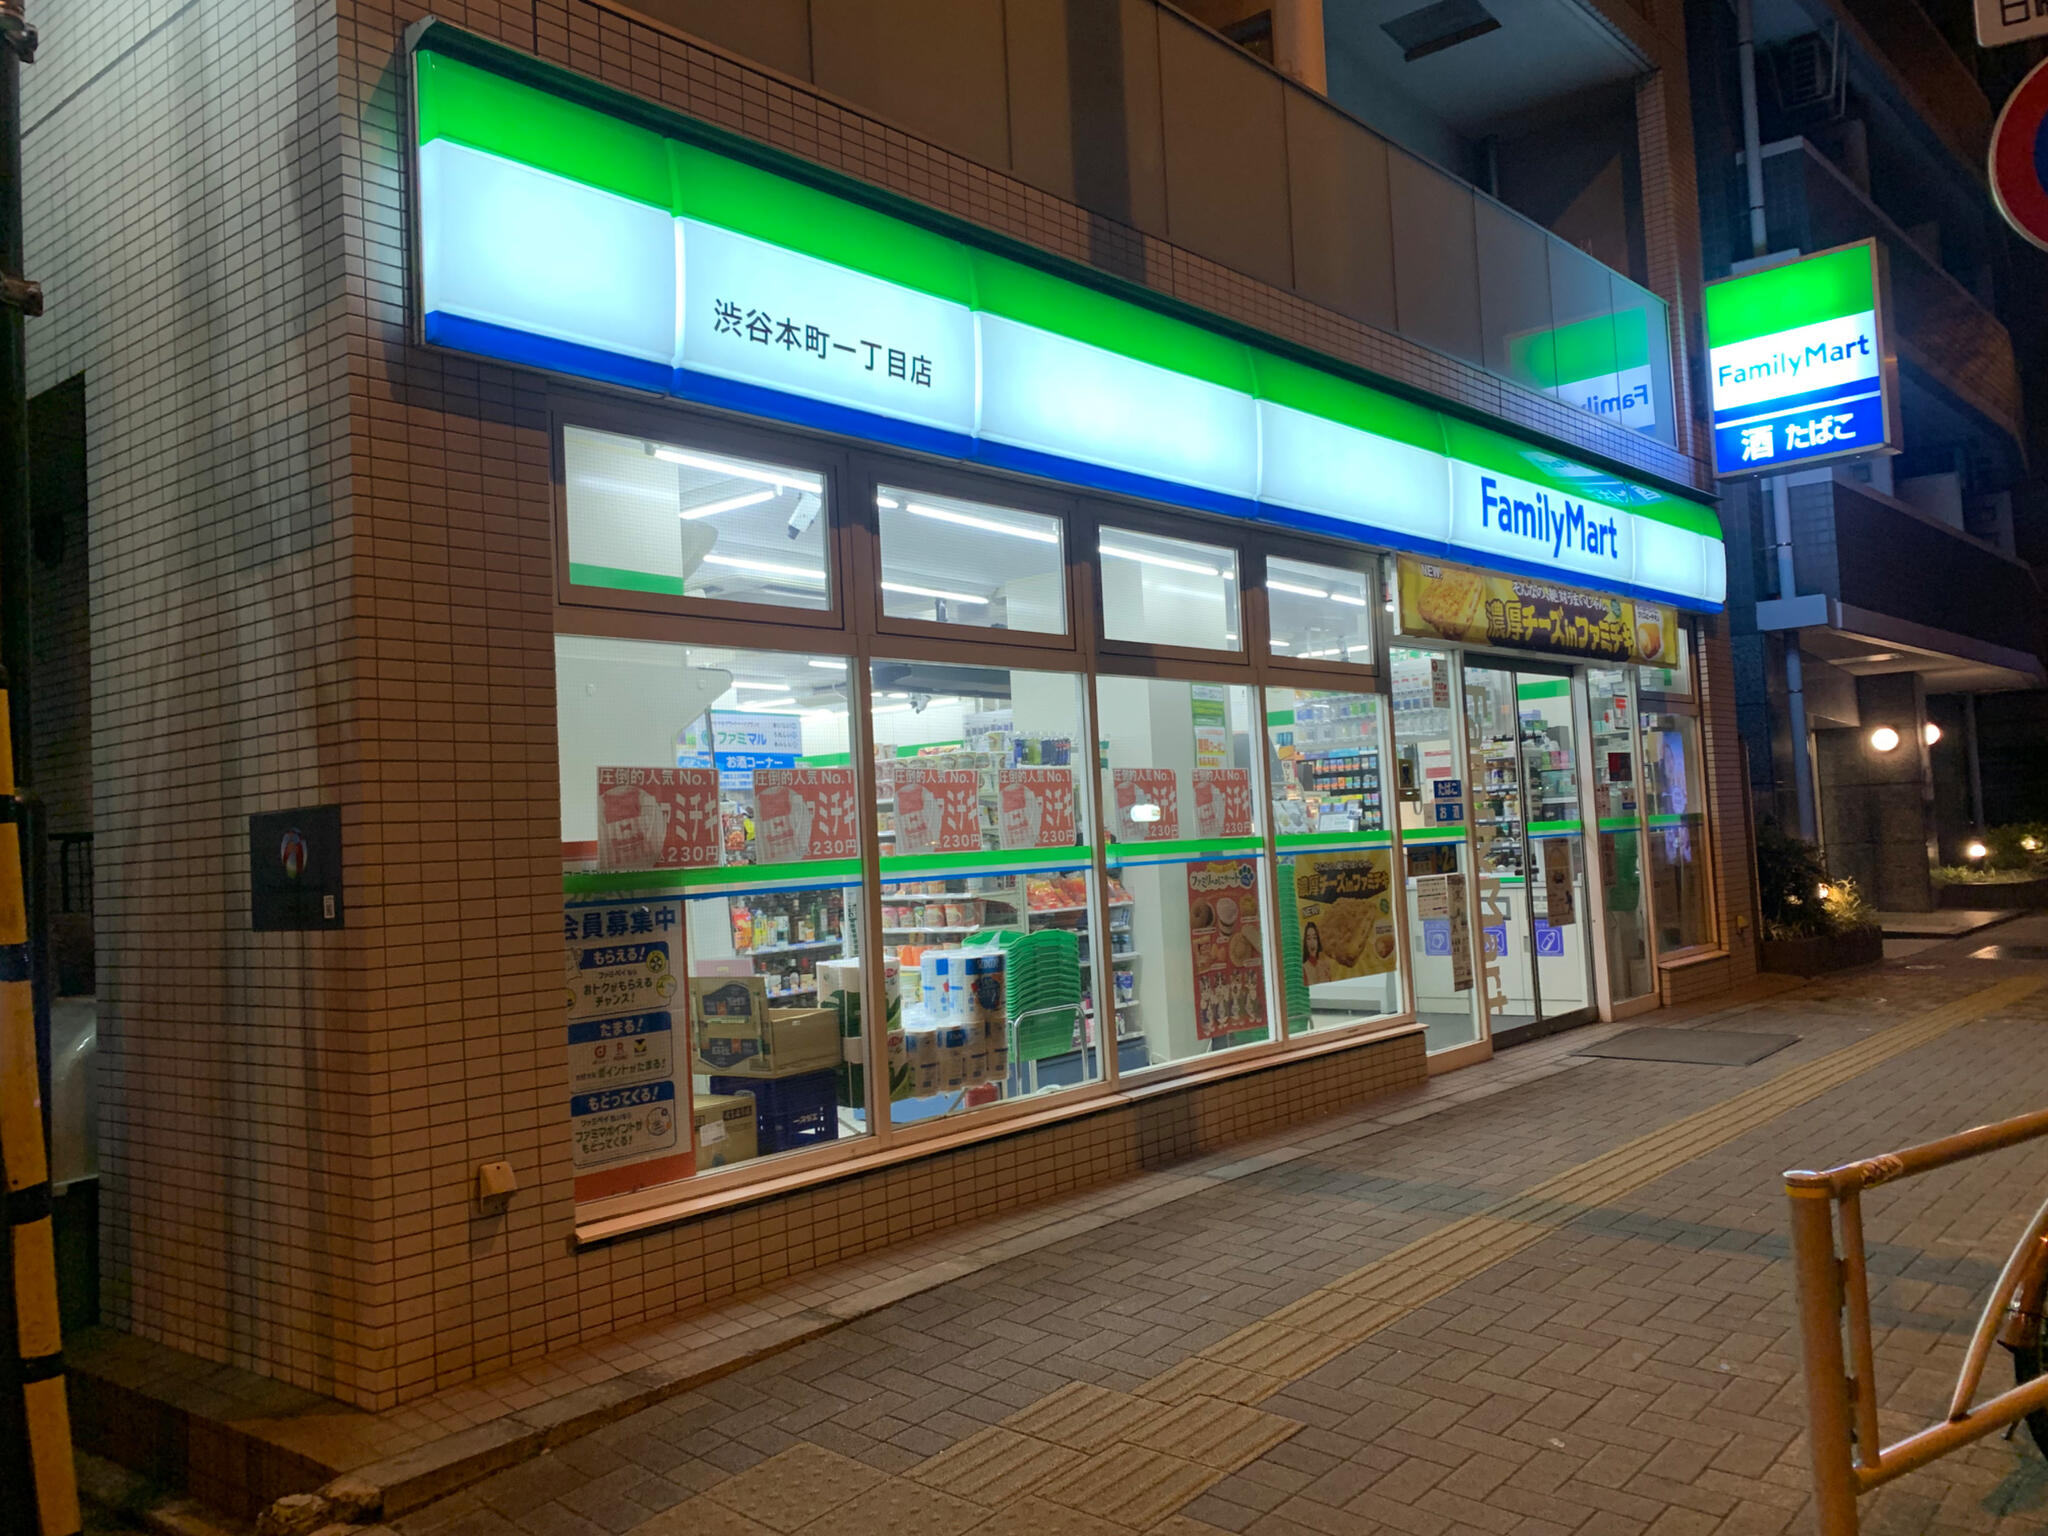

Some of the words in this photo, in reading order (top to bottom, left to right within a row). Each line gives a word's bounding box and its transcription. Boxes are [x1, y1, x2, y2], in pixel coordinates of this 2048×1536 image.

[714, 298, 932, 388] 渋谷本町一丁目店
[1718, 335, 1870, 387] FamilyMart
[1741, 425, 1774, 461] 酒
[1785, 413, 1857, 451] たばこ
[1481, 476, 1618, 559] FamilyMart
[1486, 598, 1636, 657] 濃厚チーズinファミチキ
[716, 731, 767, 745] ファミマル
[726, 756, 783, 769] お酒コーナー
[599, 769, 674, 786] 圧倒的人気
[679, 770, 715, 786] No.1
[755, 770, 818, 786] 圧倒的人気
[822, 770, 853, 786] No.1
[950, 770, 976, 784] No.1
[1047, 769, 1070, 783] No.1
[564, 905, 676, 941] 会員募集中
[588, 1086, 659, 1112] もどってくる！
